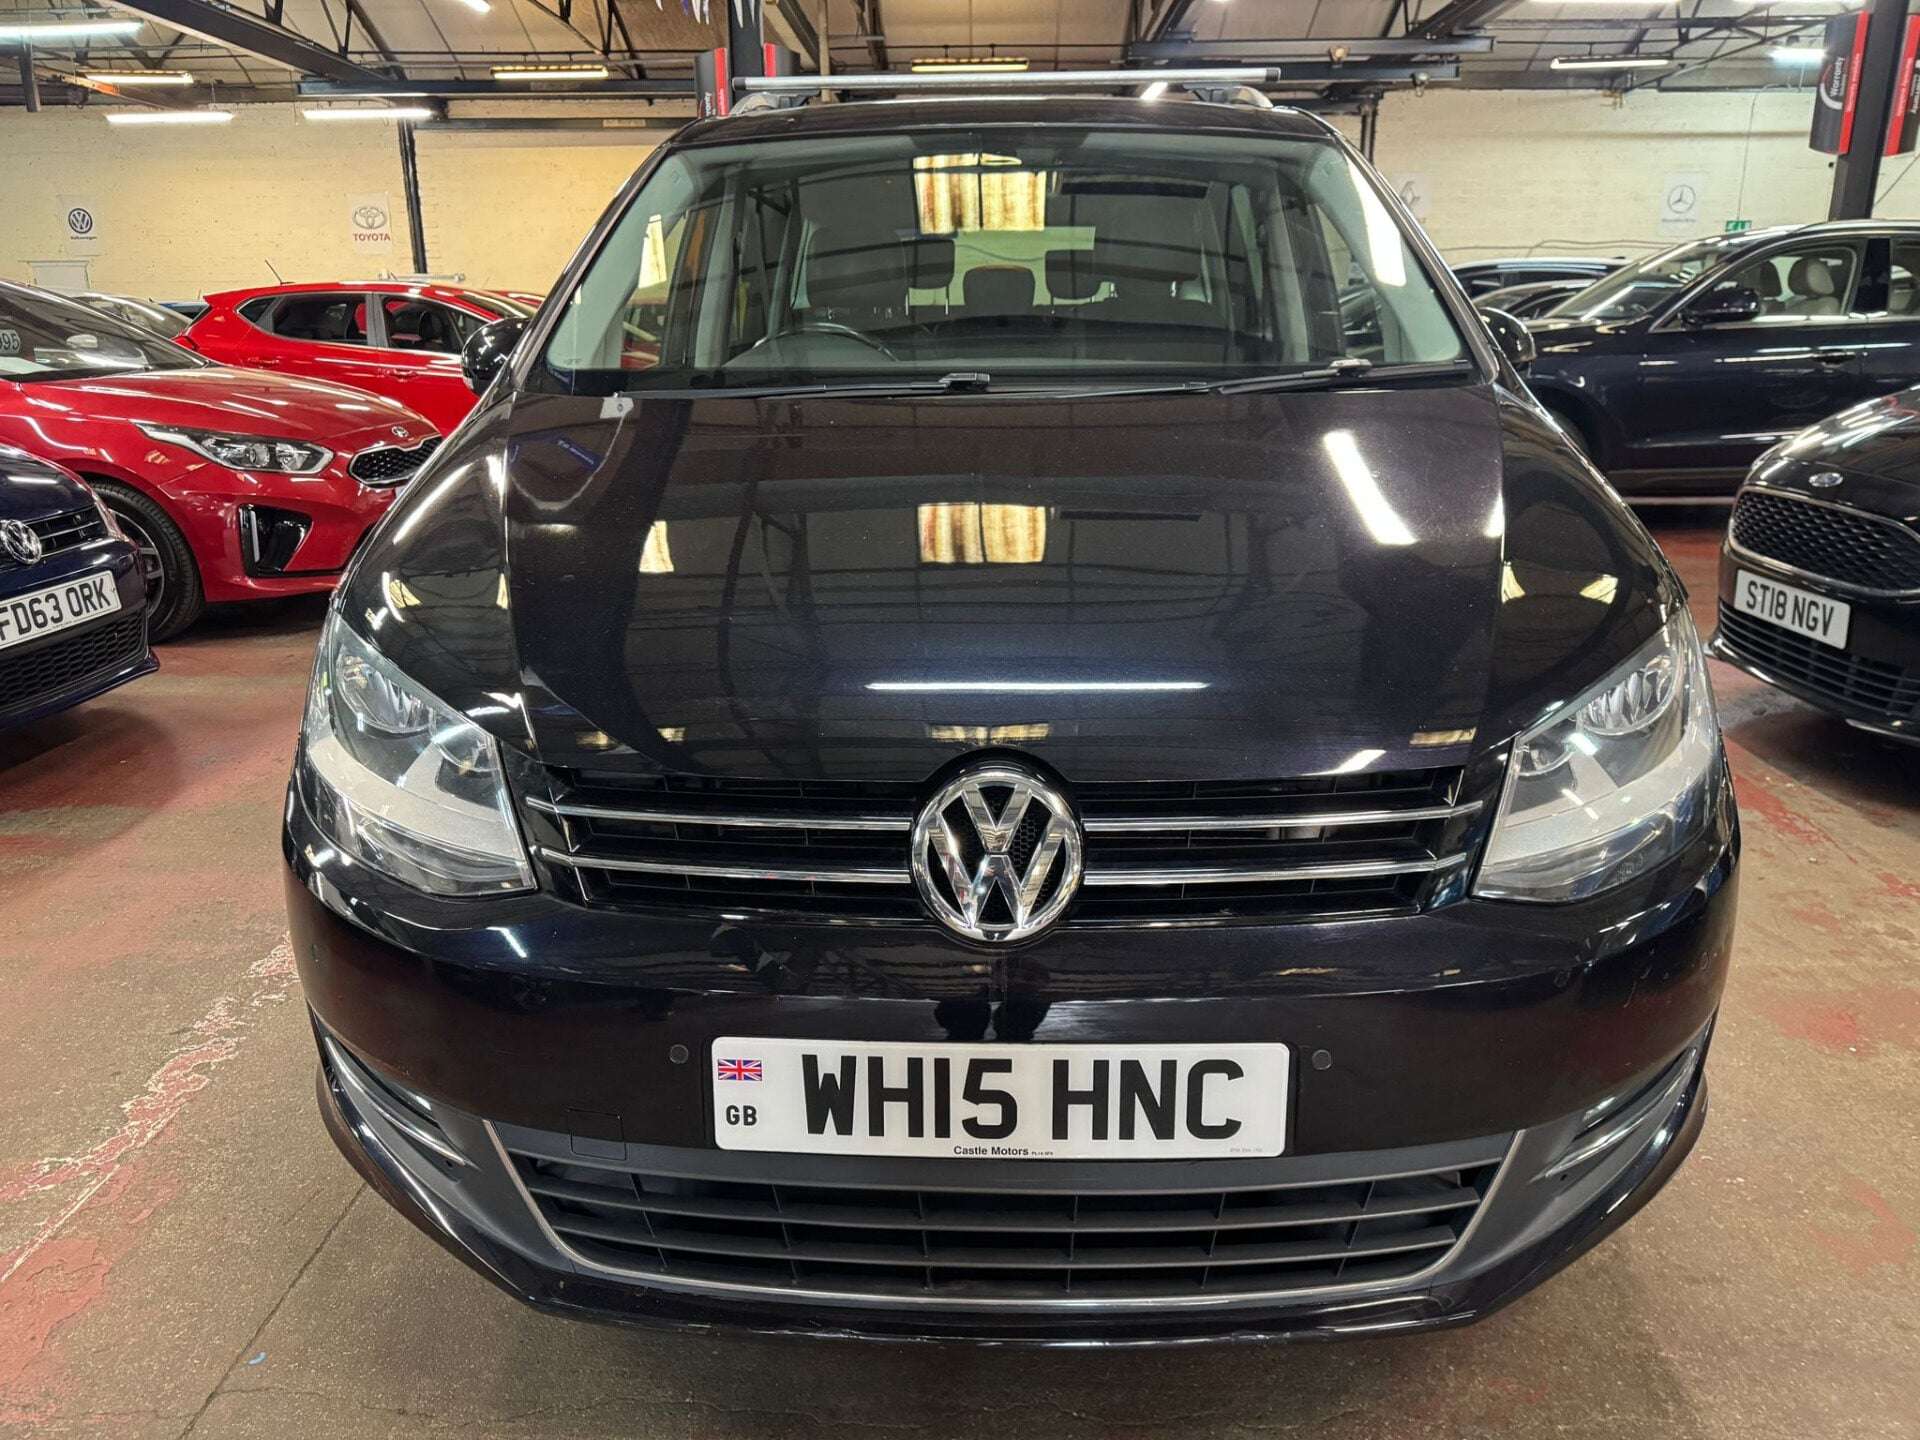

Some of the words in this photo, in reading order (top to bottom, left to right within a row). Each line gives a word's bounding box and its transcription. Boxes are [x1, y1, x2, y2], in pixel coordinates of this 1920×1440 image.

[1830, 57, 1845, 97] Warranty
[353, 233, 391, 241] TOYOTA
[0, 593, 64, 640] FD63
[65, 578, 111, 617] ORK
[1746, 580, 1788, 620] ST18
[1791, 595, 1835, 636] NGV
[725, 1105, 757, 1126] GB
[801, 1054, 1018, 1140] WH15
[1051, 1059, 1244, 1140] HNC
[953, 1145, 988, 1156] Castle
[991, 1146, 1029, 1156] Motors
